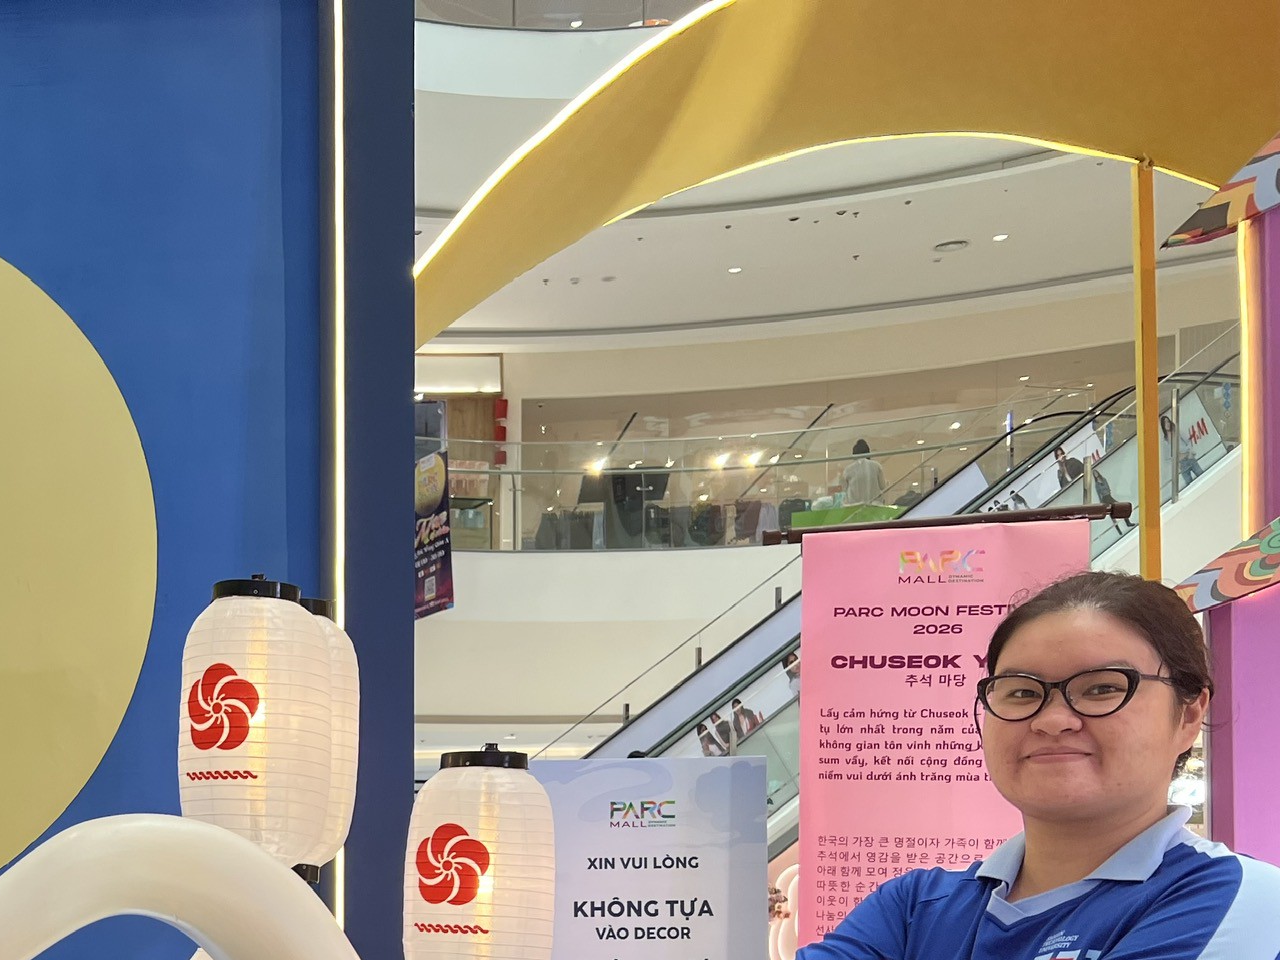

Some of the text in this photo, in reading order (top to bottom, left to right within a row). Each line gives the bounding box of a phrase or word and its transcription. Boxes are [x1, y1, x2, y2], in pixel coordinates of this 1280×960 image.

[899, 549, 986, 573] PARC
[898, 575, 947, 584] MALL
[833, 604, 950, 618] PARC MOON
[913, 623, 963, 635] 2026
[830, 654, 962, 669] CHUSEOK
[905, 673, 967, 688] 추석 마당
[820, 707, 839, 720] Lấy
[870, 708, 899, 721] hứng
[903, 708, 917, 719] từ
[920, 708, 969, 719] Chuseok
[860, 723, 886, 735] nhất
[892, 724, 924, 737] trong
[930, 725, 955, 735] năm
[819, 738, 932, 752] không gian tôn vinh
[818, 755, 949, 768] sum kết nối cộng
[846, 771, 981, 784] vui dưới ánh trăng mùa
[610, 800, 676, 819] PARC
[610, 820, 648, 828] MALL
[587, 854, 700, 870] XIN VUI LÒNG
[573, 896, 715, 921] KHÔNG TỰA
[595, 925, 691, 940] VÀO DECOR
